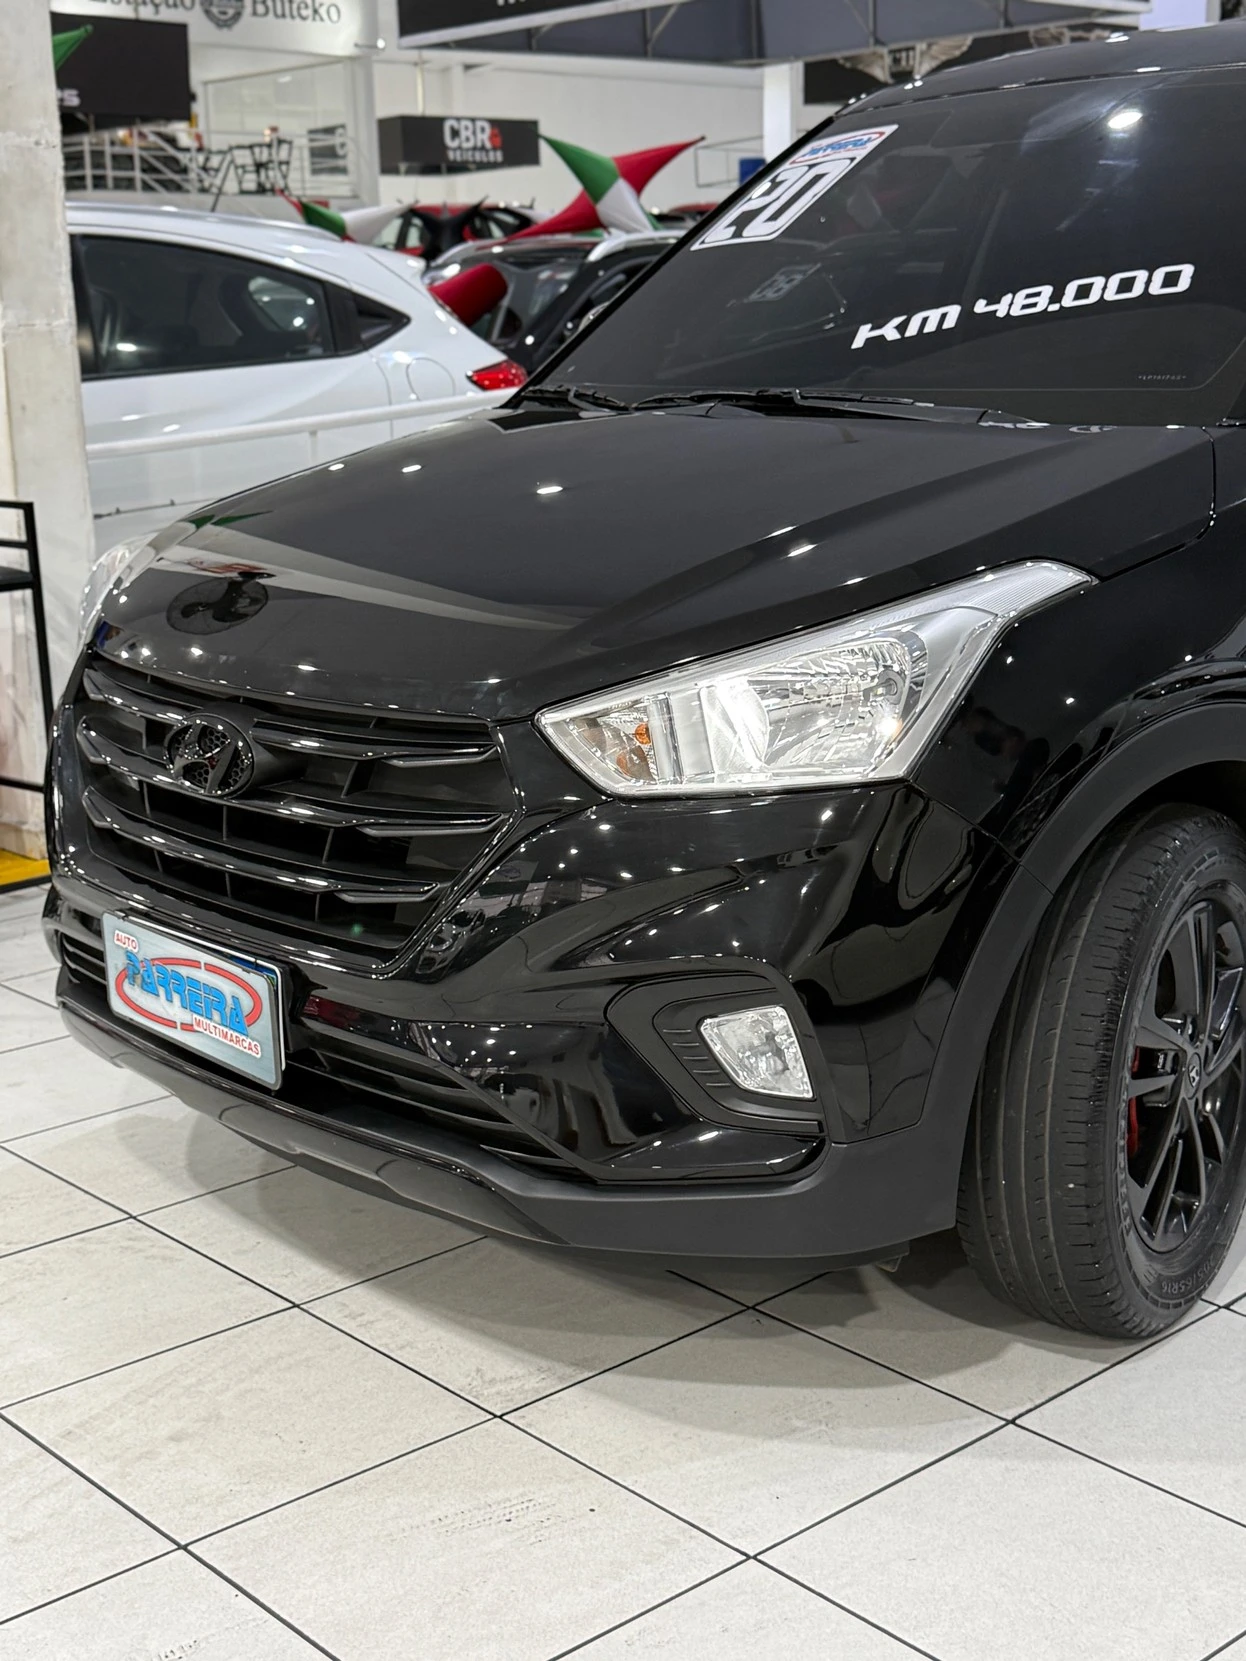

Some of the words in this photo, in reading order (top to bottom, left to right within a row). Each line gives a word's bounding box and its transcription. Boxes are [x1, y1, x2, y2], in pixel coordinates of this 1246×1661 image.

[251, 0, 341, 23] Buteko
[443, 118, 493, 149] CBR
[703, 158, 852, 243] 20
[850, 304, 962, 349] KM
[973, 263, 1195, 318] 48.000
[115, 932, 138, 951] AUTO
[125, 950, 249, 1037] PARREIRA
[194, 1016, 260, 1056] MULTIMARCAS
